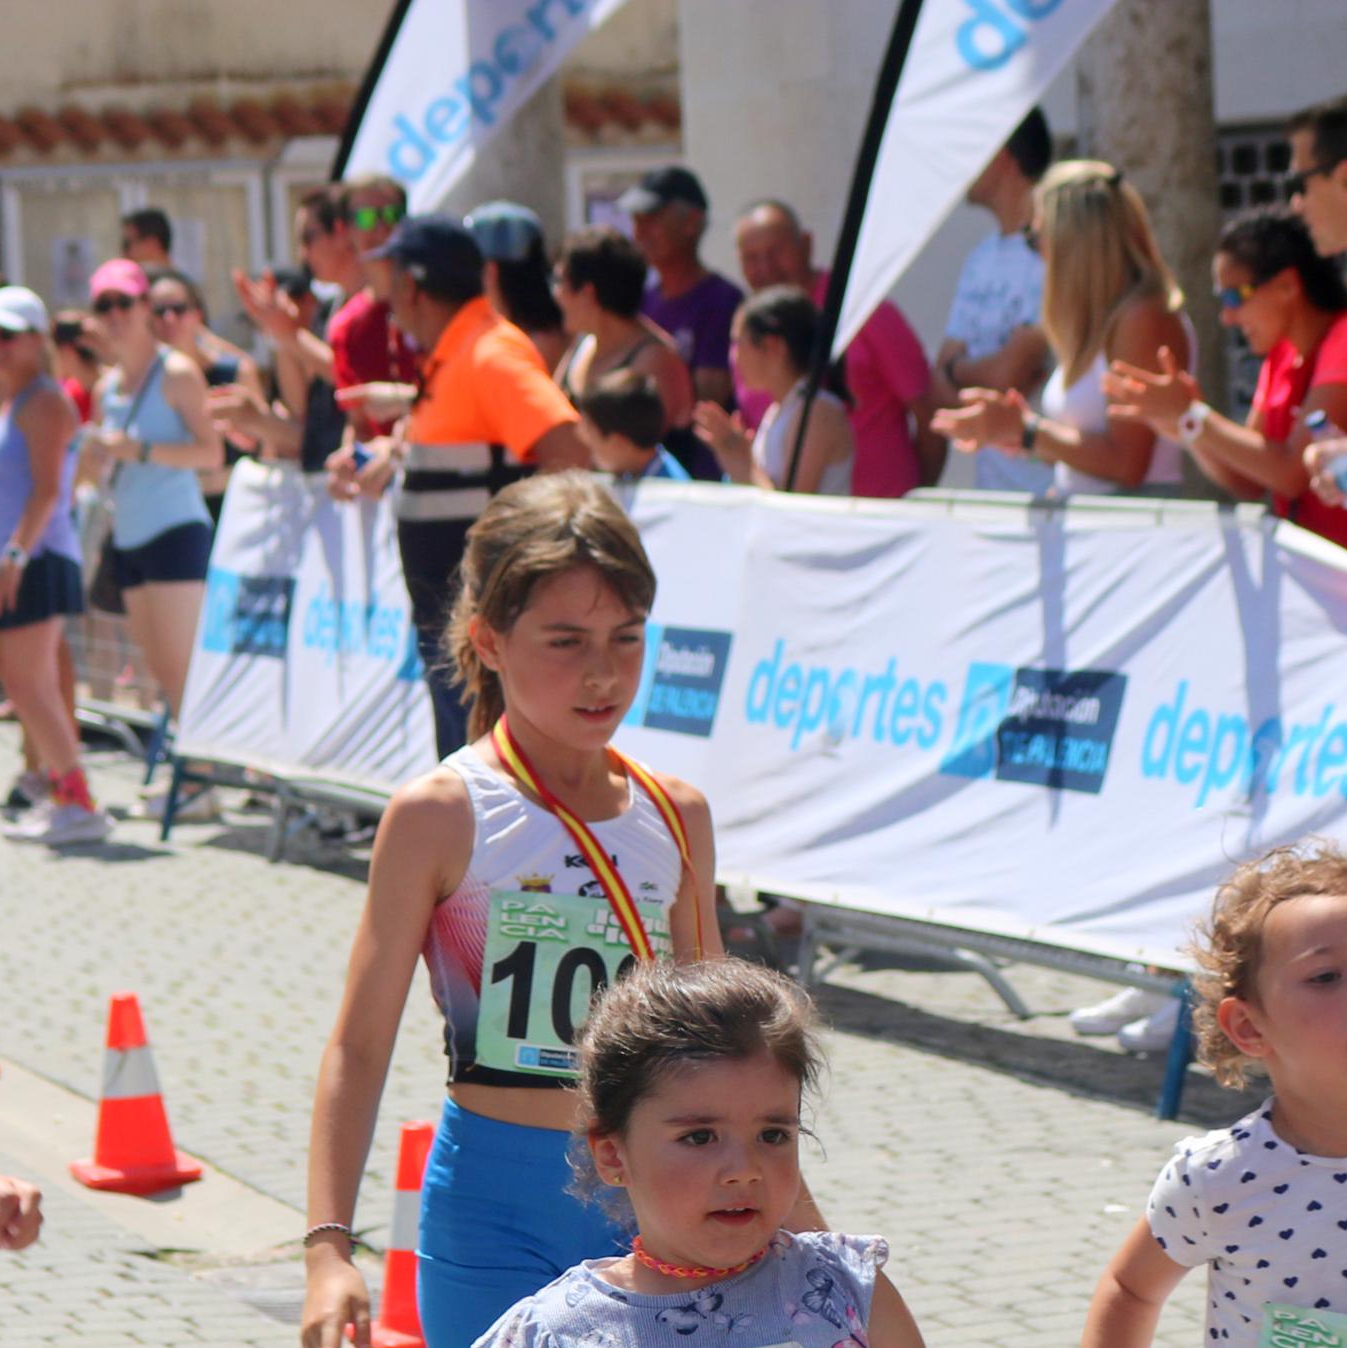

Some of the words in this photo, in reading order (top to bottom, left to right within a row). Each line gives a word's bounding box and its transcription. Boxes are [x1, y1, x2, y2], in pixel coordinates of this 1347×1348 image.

[745, 638, 947, 751] deportes
[502, 901, 555, 914] PA
[502, 912, 566, 928] LEN
[501, 924, 567, 941] CIA
[1273, 1310, 1328, 1332] PA
[1272, 1320, 1340, 1346] LEN
